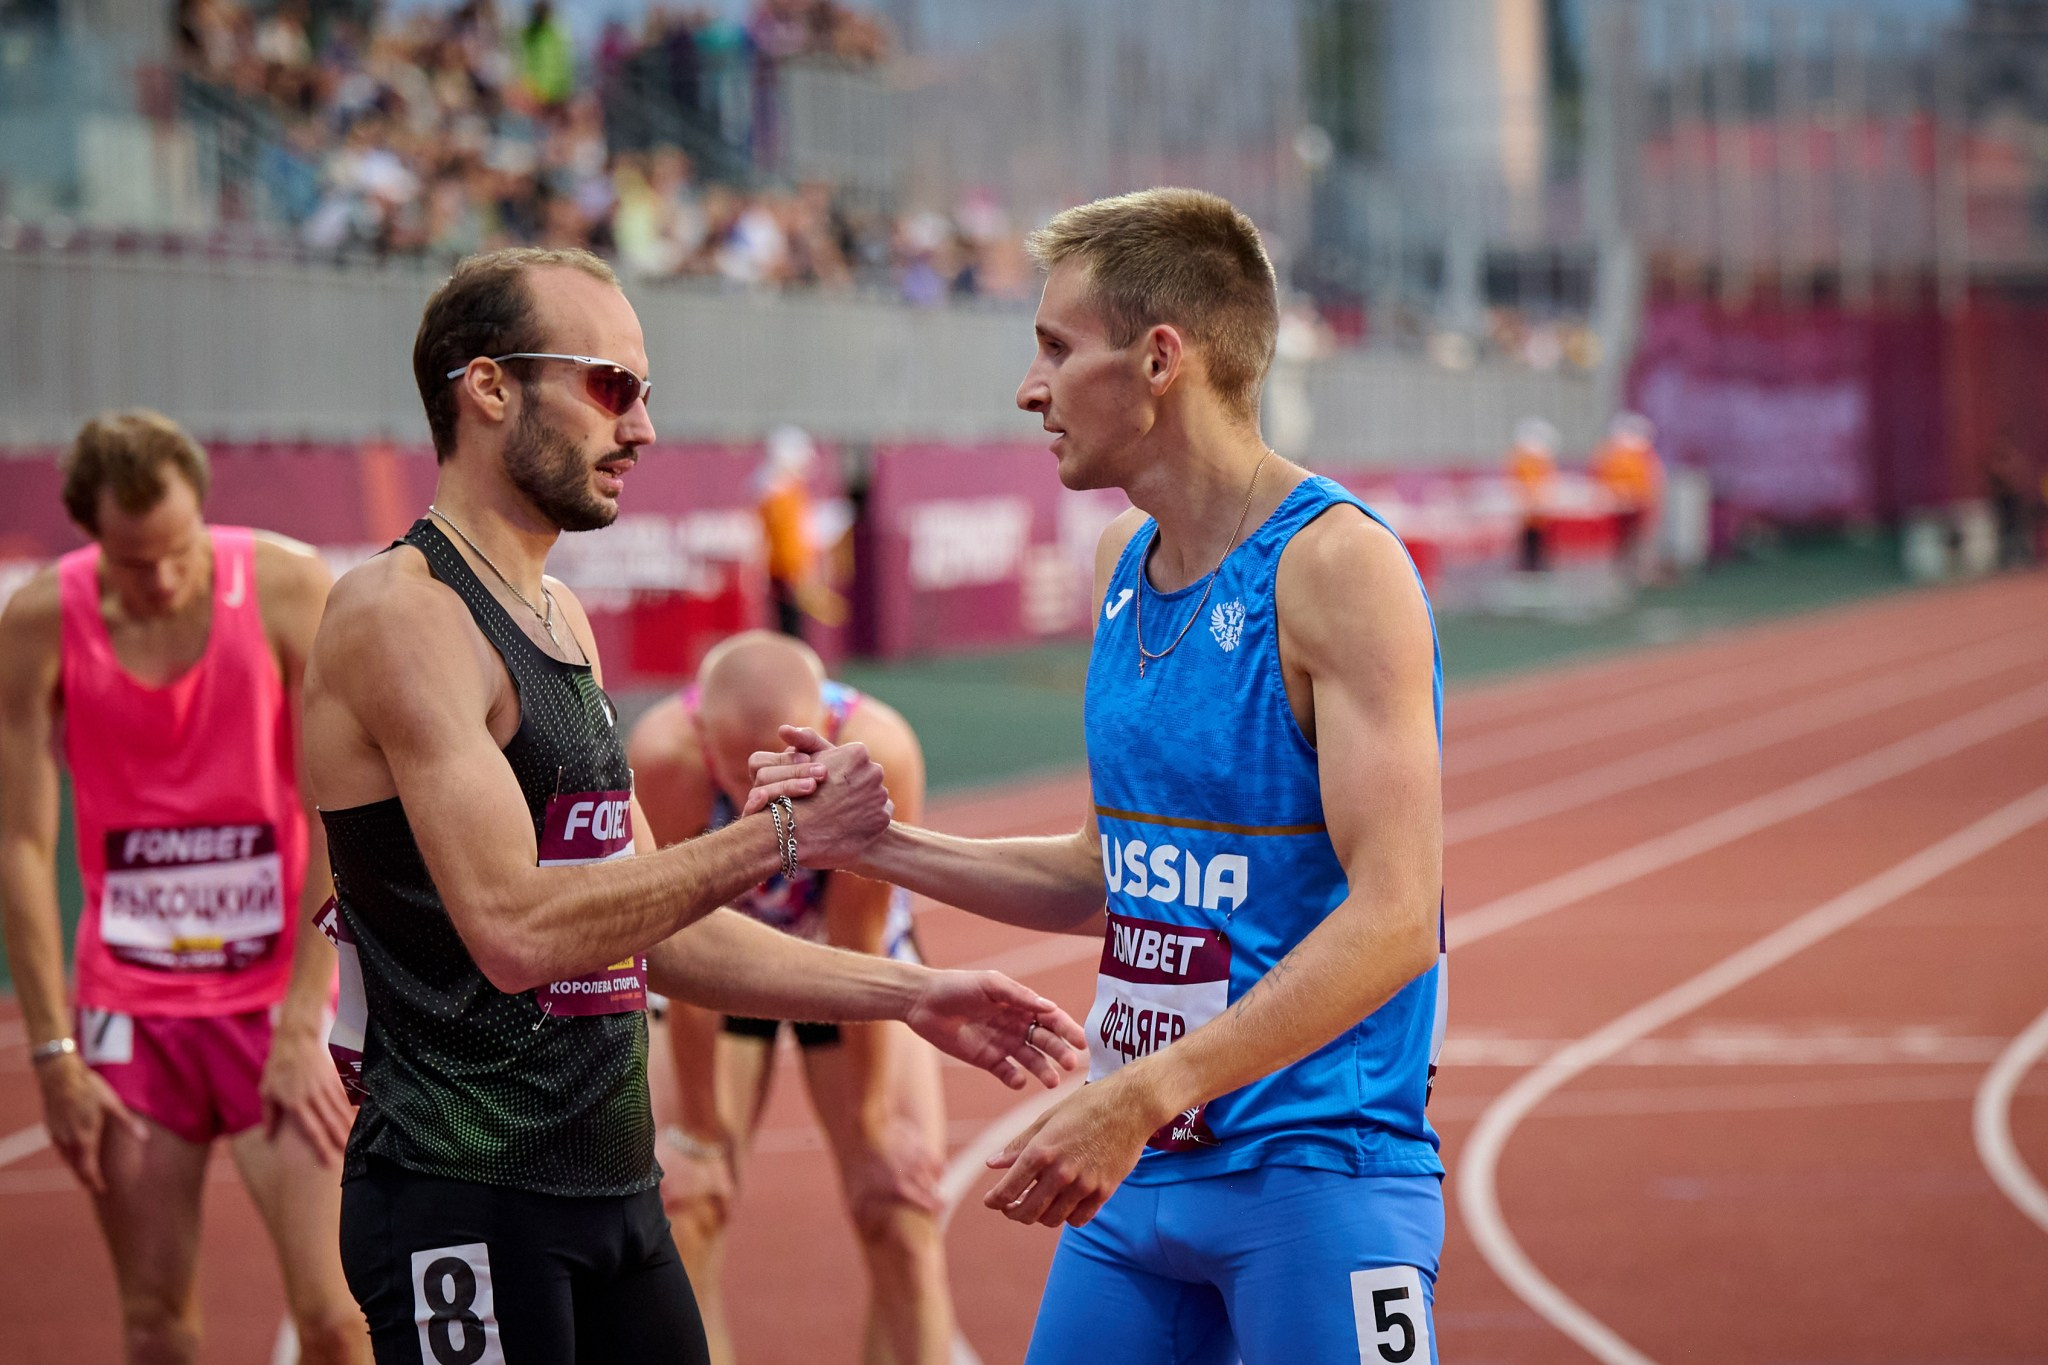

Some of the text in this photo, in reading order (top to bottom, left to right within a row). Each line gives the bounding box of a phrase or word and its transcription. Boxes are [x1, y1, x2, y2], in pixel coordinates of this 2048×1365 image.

[123, 825, 262, 864] FONBET
[550, 976, 640, 994] КОРОЛЕВА СПОРТА
[423, 1256, 487, 1365] 8
[1372, 1286, 1416, 1364] 5
